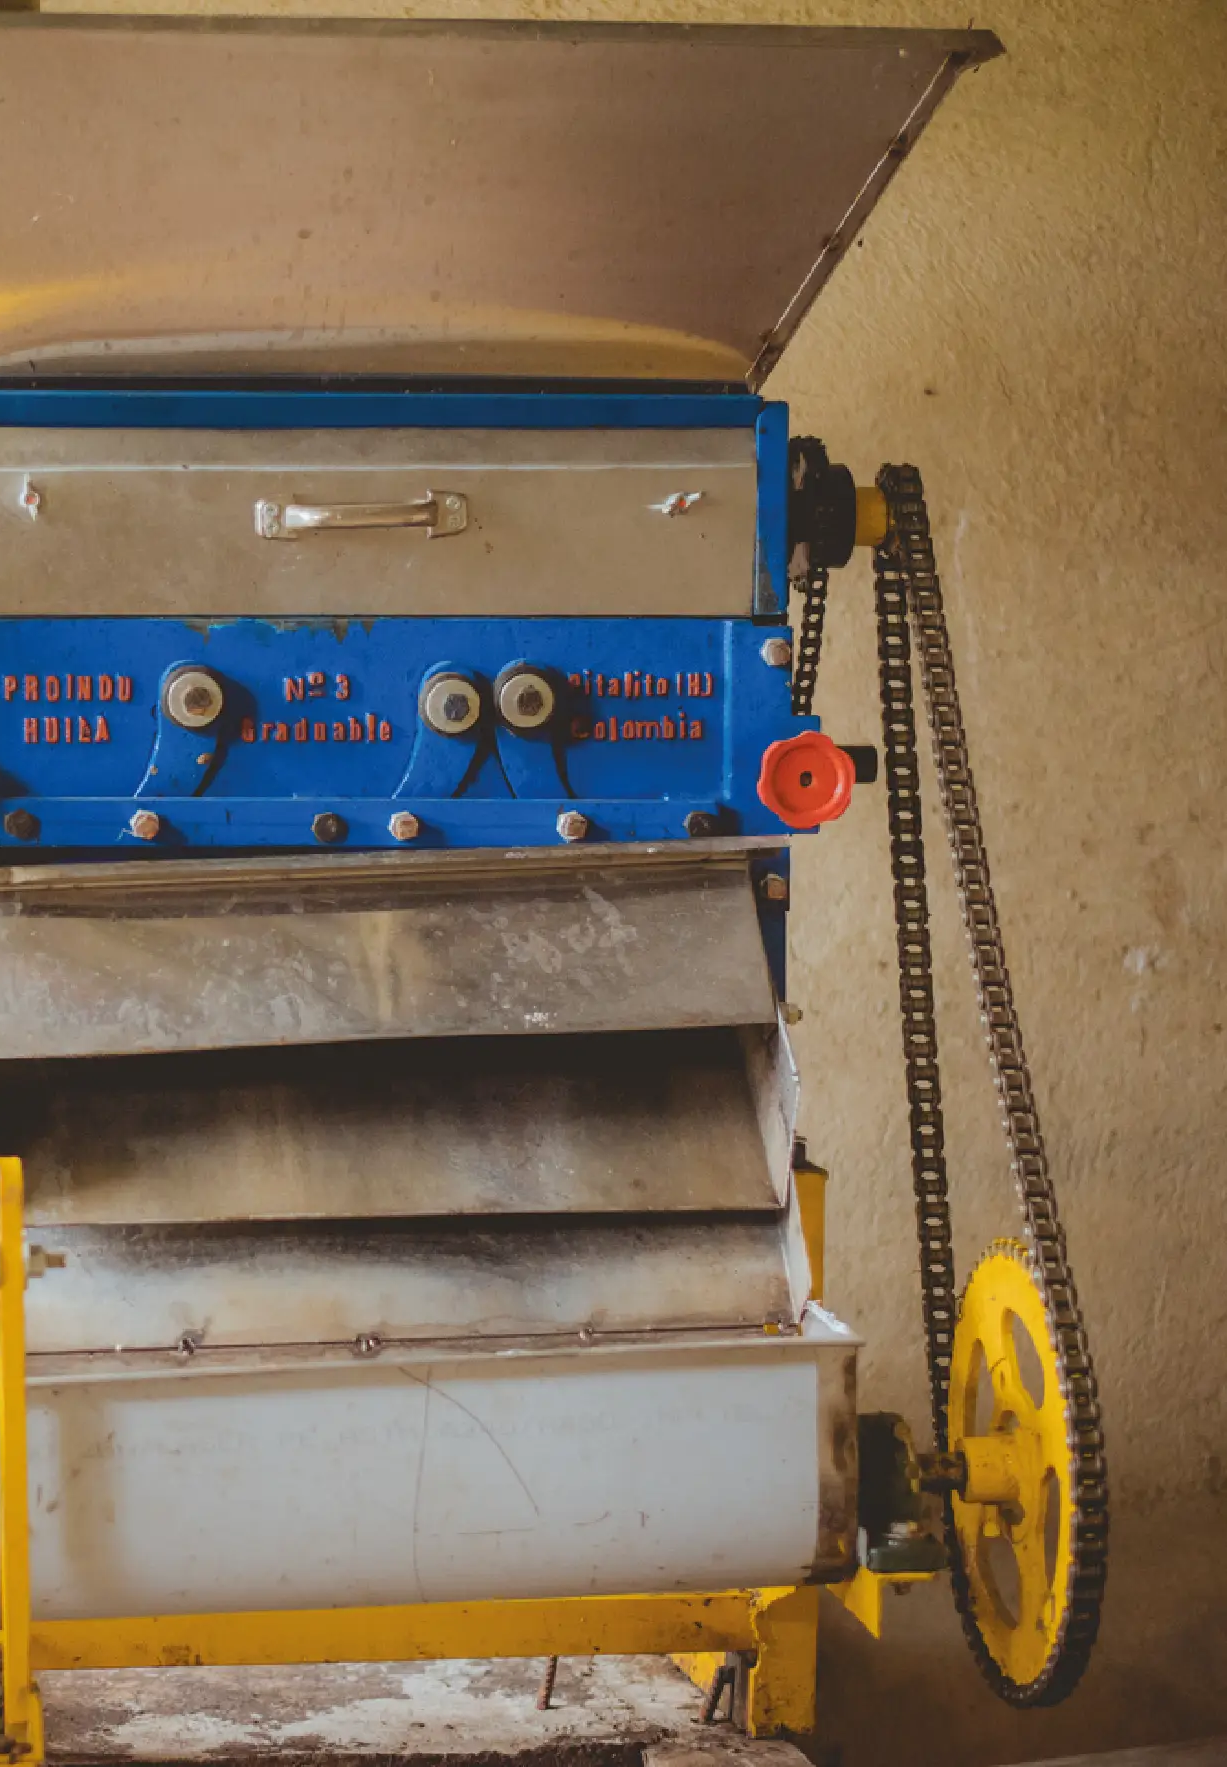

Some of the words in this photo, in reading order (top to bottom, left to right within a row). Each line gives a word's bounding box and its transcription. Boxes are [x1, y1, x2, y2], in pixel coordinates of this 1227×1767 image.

[3, 674, 132, 702] PROINDU
[334, 673, 351, 700] 3
[23, 716, 110, 744] HUILA
[241, 711, 393, 743] Graduable
[571, 710, 703, 741] Colombia
